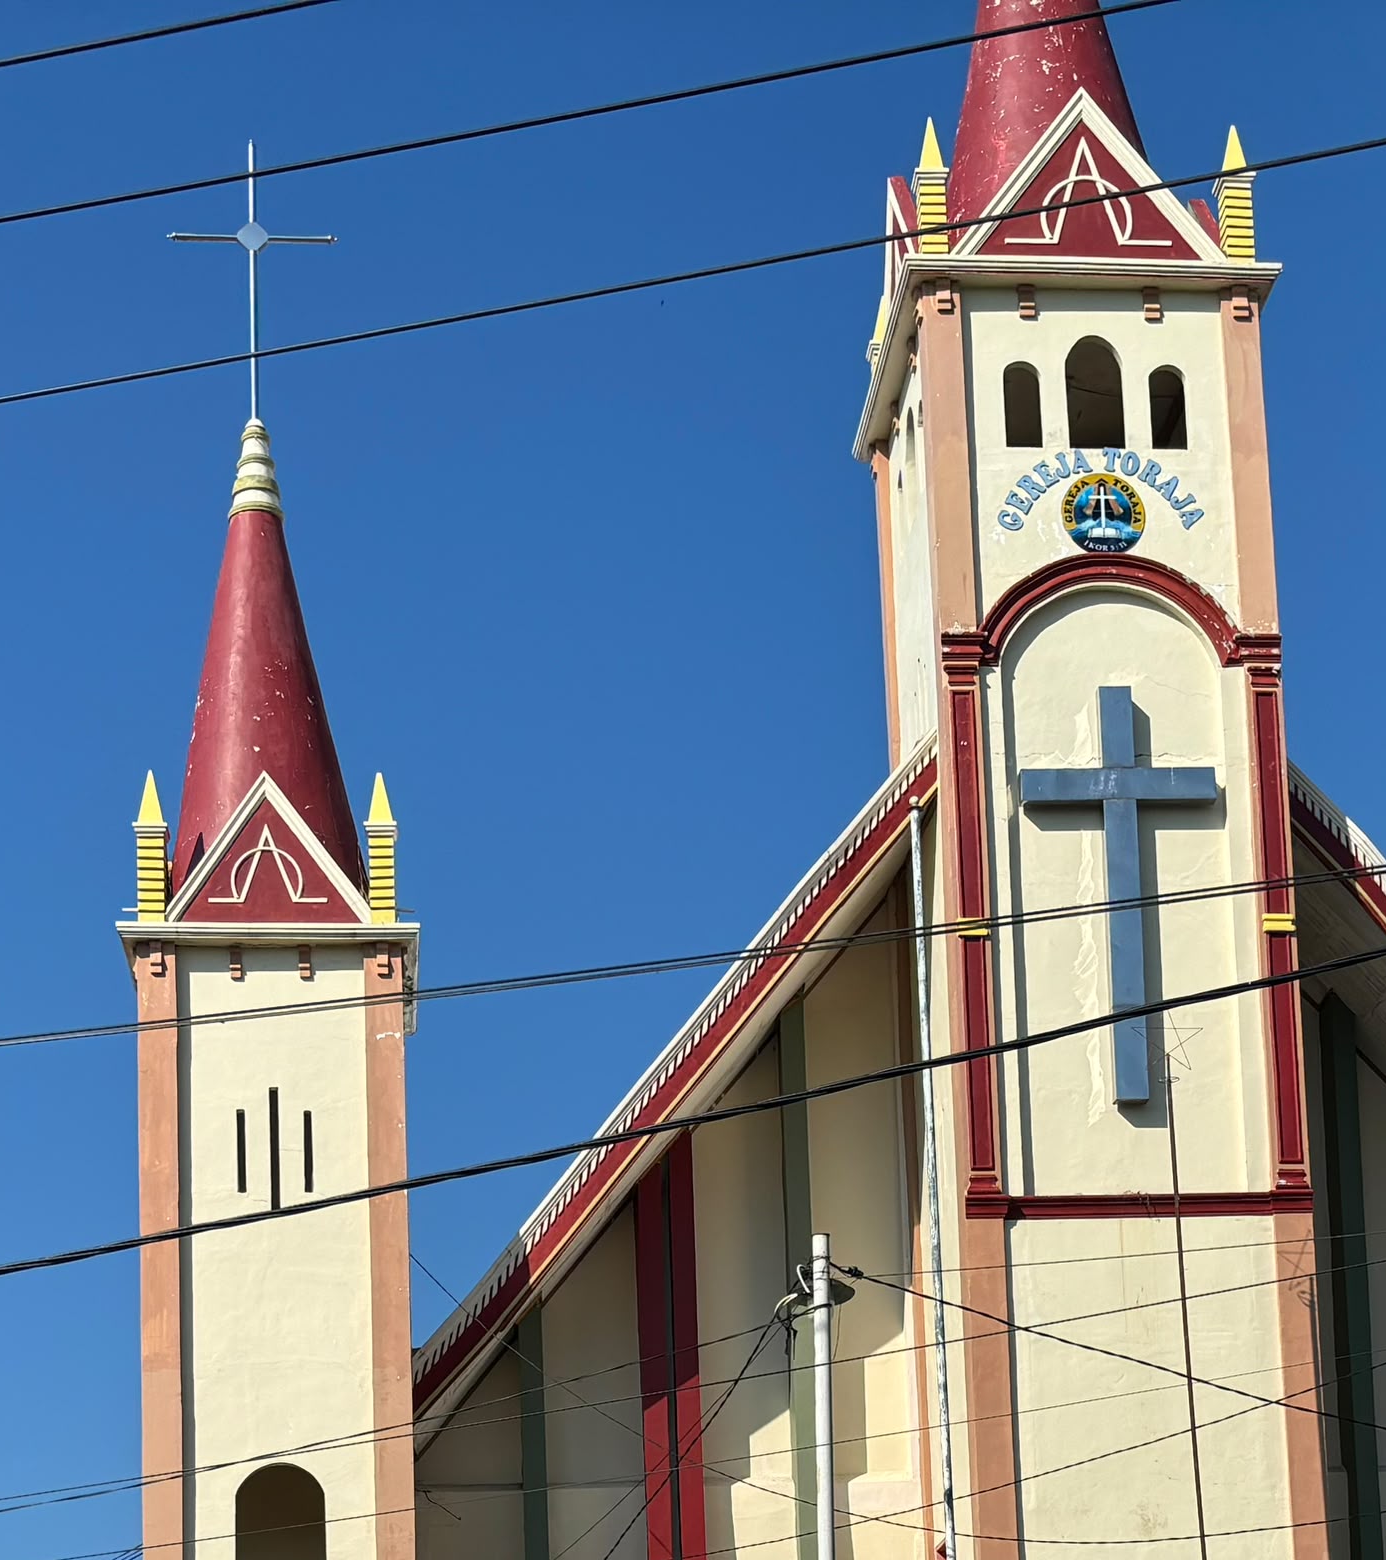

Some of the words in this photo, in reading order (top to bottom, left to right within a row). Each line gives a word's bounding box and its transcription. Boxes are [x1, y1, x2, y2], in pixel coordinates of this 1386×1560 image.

[997, 448, 1093, 531] GEREJA
[1102, 446, 1204, 530] TORAJA
[1064, 480, 1091, 523] GEREJA
[1112, 478, 1142, 525] TORAJA
